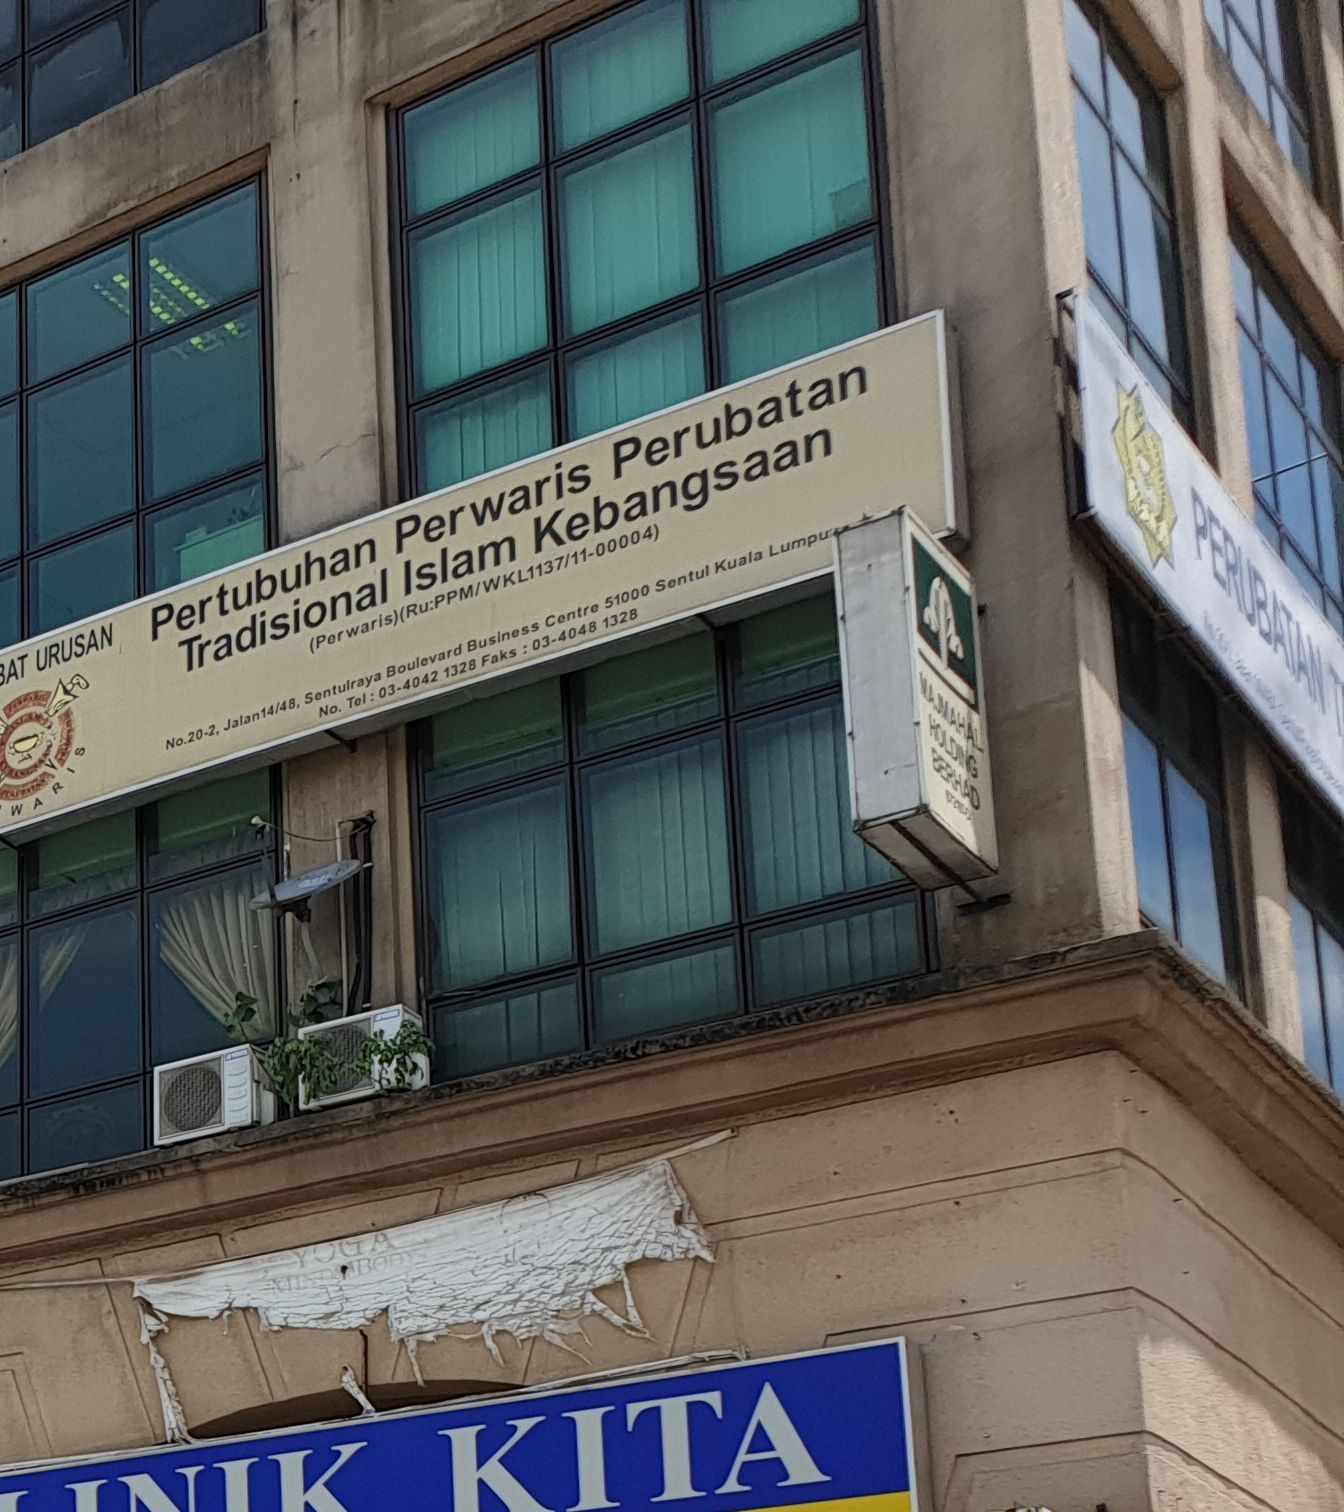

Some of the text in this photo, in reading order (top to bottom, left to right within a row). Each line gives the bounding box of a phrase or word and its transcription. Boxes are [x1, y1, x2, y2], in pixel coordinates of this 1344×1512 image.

[151, 365, 867, 641] Pertubuhan Perwaris Perubatan
[178, 429, 833, 672] Tradisional Islam Kebangsaan
[37, 622, 114, 671] URUSAN
[304, 668, 381, 704] Sentulraya
[386, 642, 463, 682] Boulevard
[467, 623, 540, 655] Business
[544, 601, 599, 629] Centre
[605, 585, 650, 609] 51000
[654, 566, 710, 595] Sentul
[714, 548, 763, 576] Kuala
[318, 699, 345, 719] No.
[378, 670, 440, 702] 03-4042
[443, 660, 476, 682] 1328
[480, 647, 517, 670] Faks
[532, 621, 599, 652] 03-4048
[603, 607, 638, 634] 1328
[1190, 486, 1326, 715] PERUBATAN
[928, 714, 978, 779] HOLDING
[931, 747, 980, 810] BERHAD
